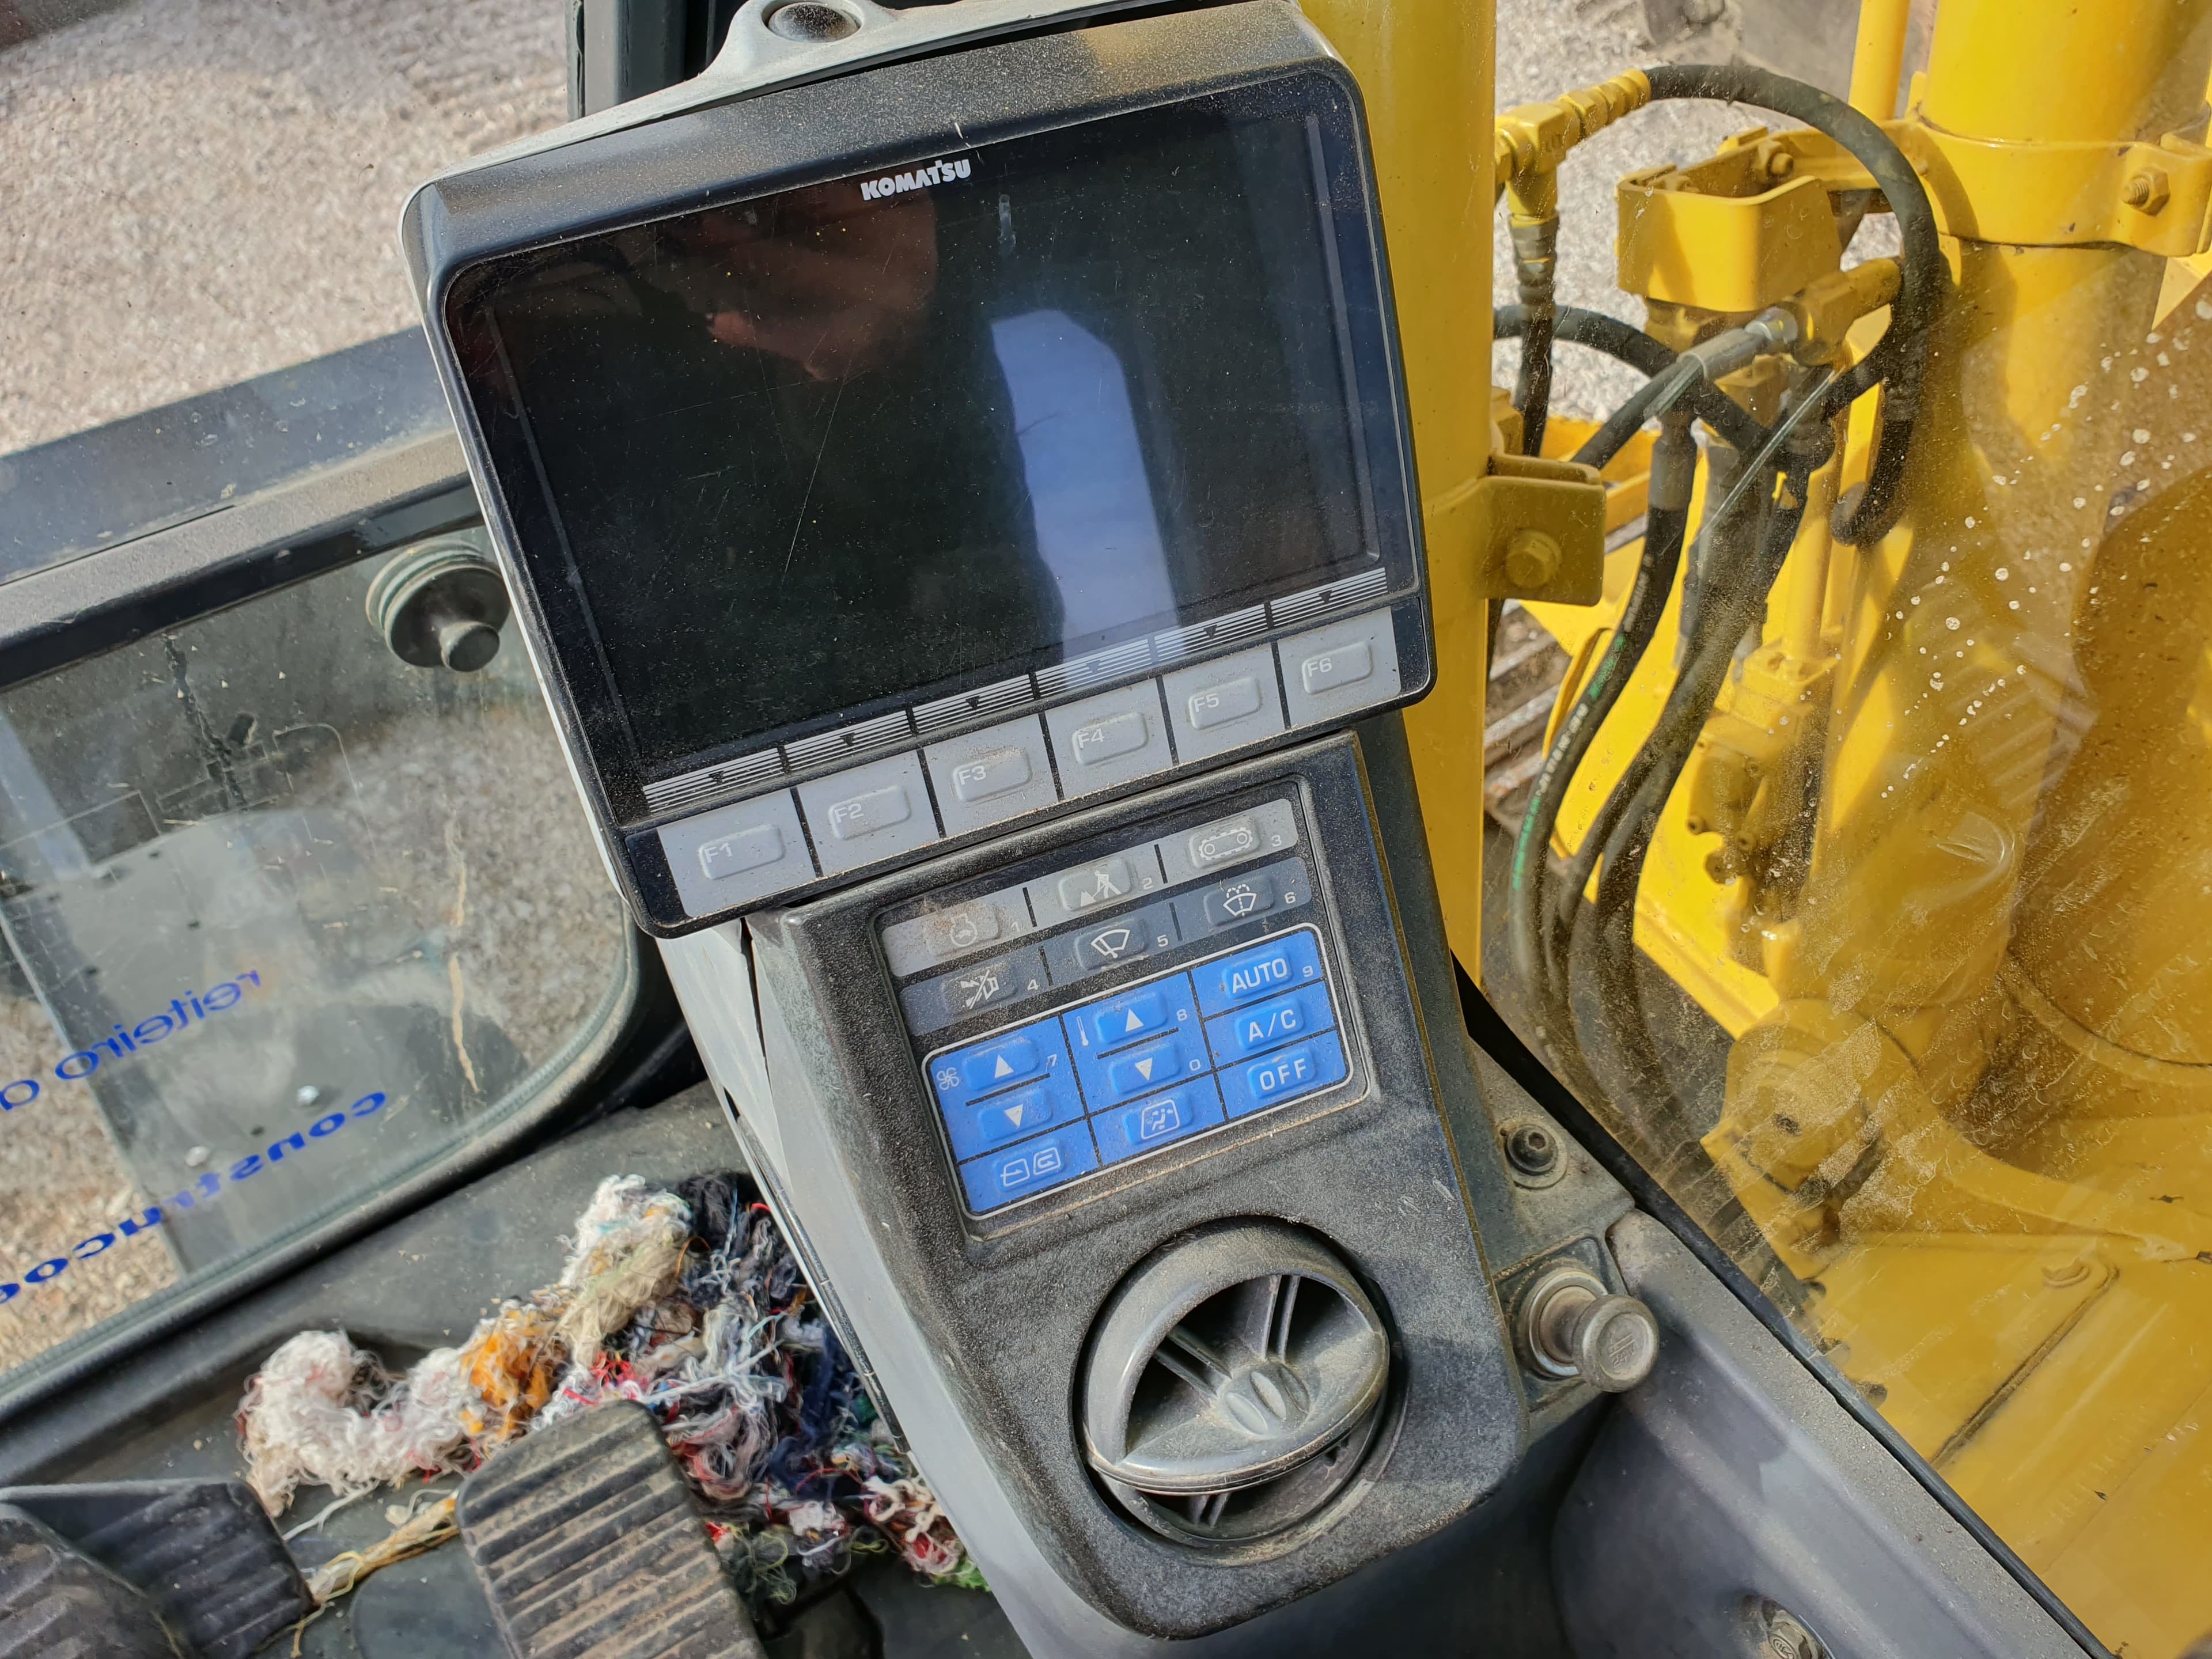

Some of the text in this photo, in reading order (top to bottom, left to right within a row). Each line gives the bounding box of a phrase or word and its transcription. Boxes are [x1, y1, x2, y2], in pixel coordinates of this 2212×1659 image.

[861, 159, 971, 201] KOMATSU
[1307, 658, 1332, 677] F6
[1193, 693, 1220, 713] F5
[1077, 728, 1105, 749] F4
[958, 765, 987, 785] F3
[834, 803, 864, 823] F2
[1271, 834, 1282, 847] 3
[704, 842, 733, 863] F1
[1142, 877, 1154, 890] 2
[1284, 892, 1296, 904] 6
[1010, 921, 1020, 933] 1
[1157, 934, 1169, 948] 5
[1232, 957, 1287, 994] AUTO
[1302, 965, 1314, 978] 9
[1027, 979, 1039, 991] 4
[1176, 1009, 1188, 1022] 8
[1248, 1008, 1297, 1043] A/C
[1047, 1054, 1057, 1067] 7
[1259, 1056, 1307, 1091] OFF
